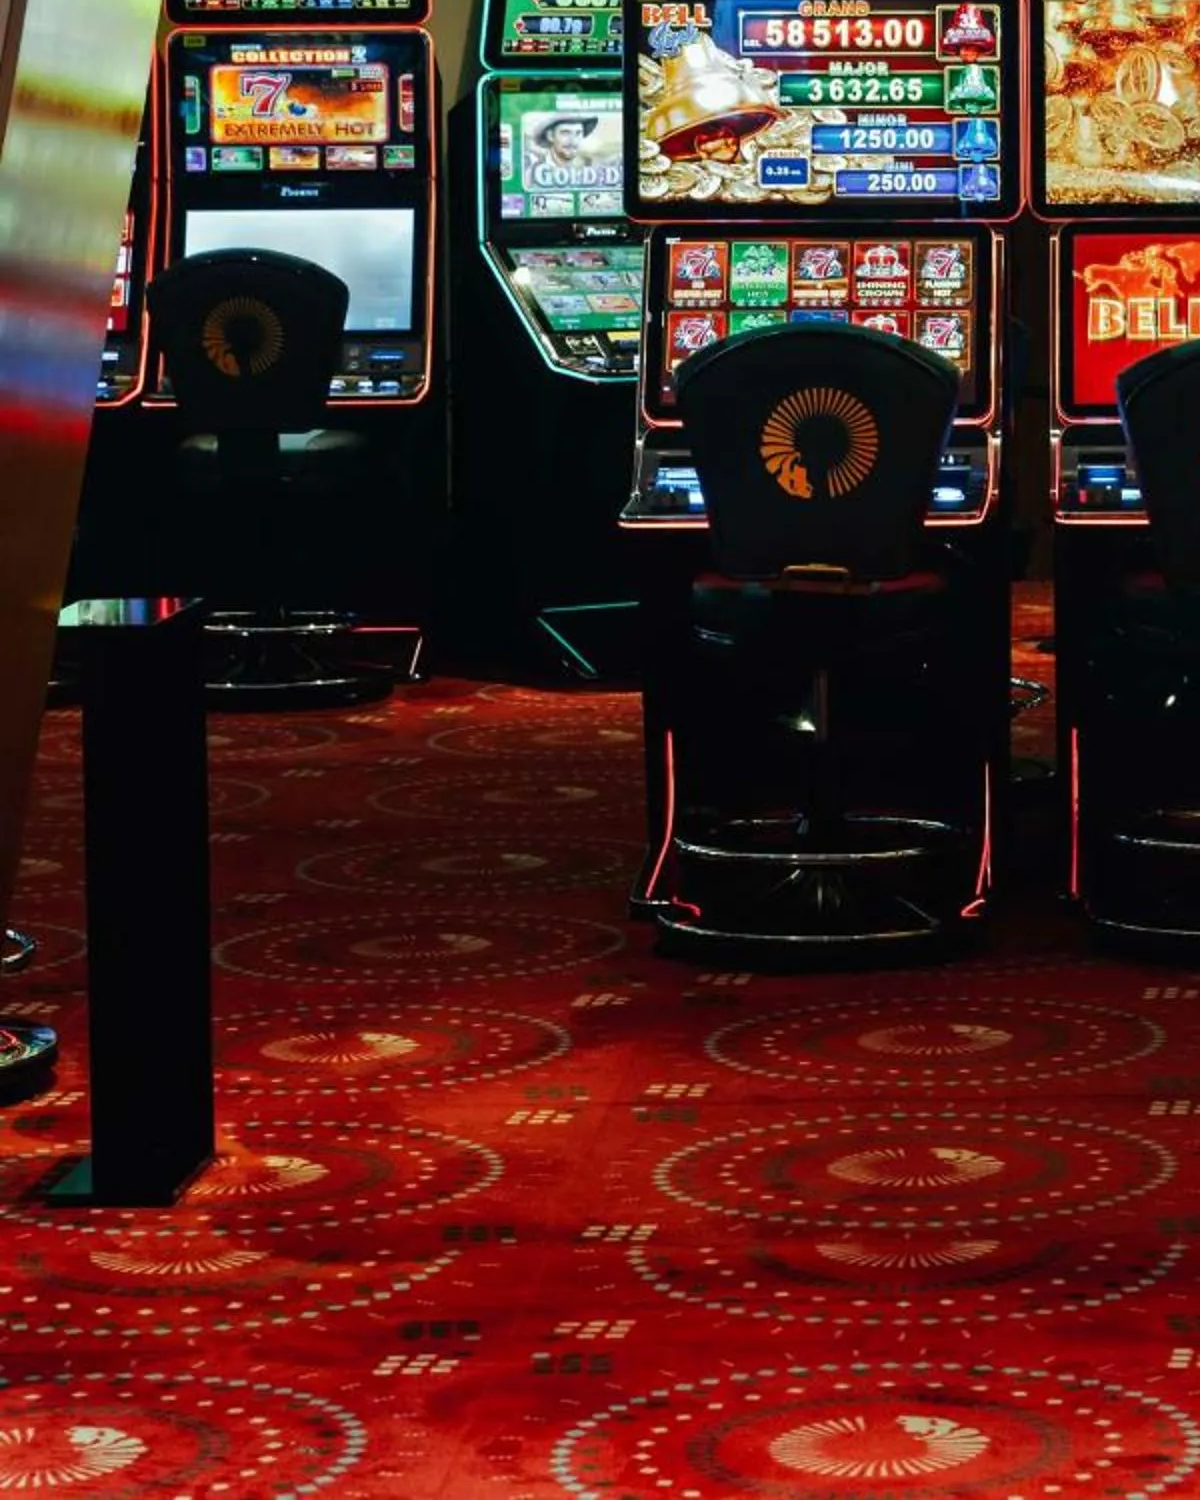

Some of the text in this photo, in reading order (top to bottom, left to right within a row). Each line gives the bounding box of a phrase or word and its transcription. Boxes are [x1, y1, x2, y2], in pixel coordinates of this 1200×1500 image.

[641, 3, 713, 28] BELL
[798, 0, 870, 17] GRAND
[231, 49, 350, 63] COLLECTION
[828, 61, 888, 77] MAJOR
[857, 113, 907, 128] MINOR
[224, 121, 376, 137] EXTREMELY HOT
[840, 129, 934, 149] 1250.00
[868, 173, 937, 192] 250.00
